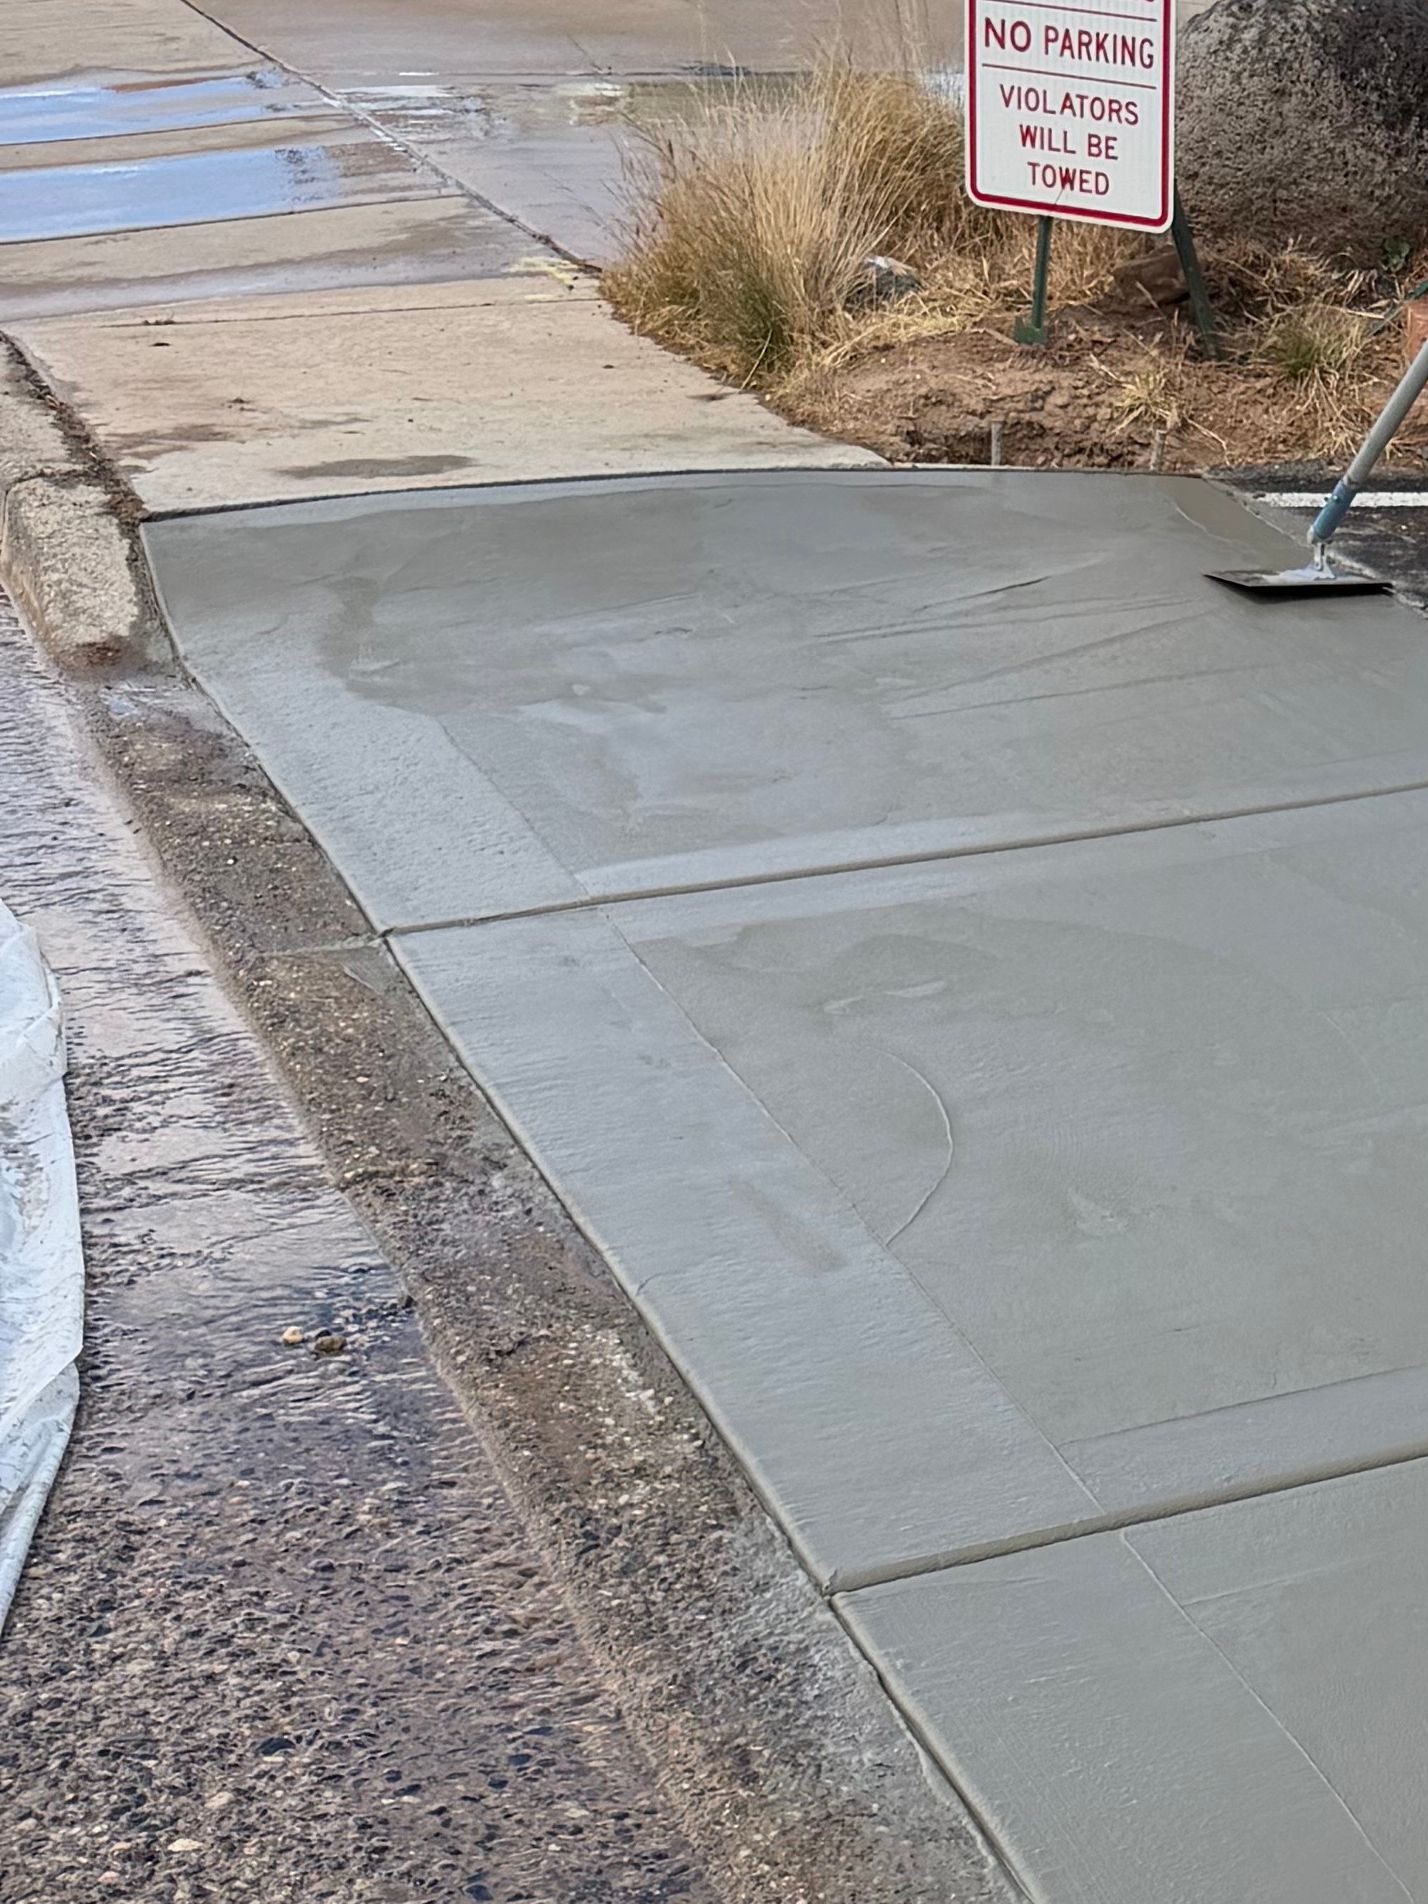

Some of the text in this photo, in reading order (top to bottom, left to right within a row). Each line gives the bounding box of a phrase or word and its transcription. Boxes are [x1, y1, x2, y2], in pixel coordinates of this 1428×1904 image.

[984, 16, 1154, 69] NO PARKING
[999, 83, 1139, 126] VIOLATORS
[1019, 124, 1118, 161] WILL BE
[1026, 161, 1110, 196] TOWED
